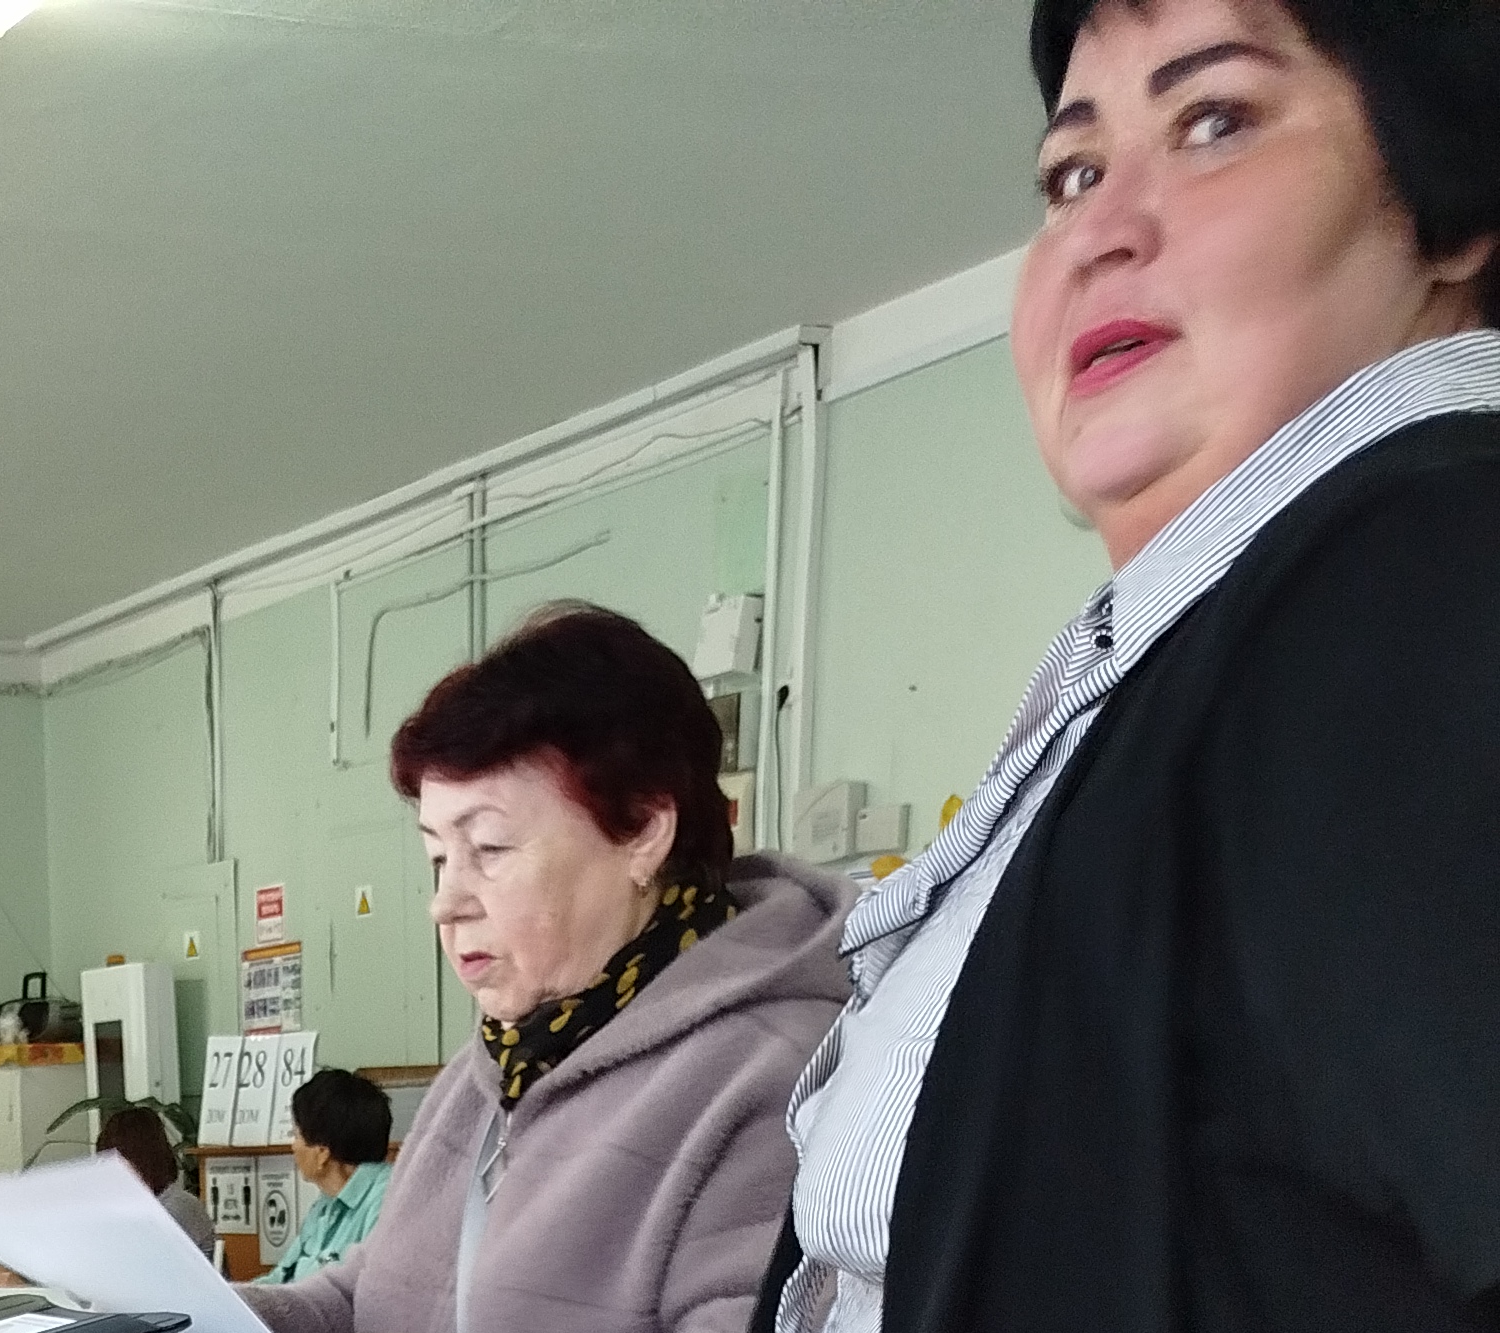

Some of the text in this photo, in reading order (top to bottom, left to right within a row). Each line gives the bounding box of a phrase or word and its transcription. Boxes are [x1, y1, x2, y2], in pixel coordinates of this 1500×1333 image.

[209, 1051, 233, 1089] 27
[237, 1050, 267, 1089] 28
[281, 1047, 305, 1088] 84
